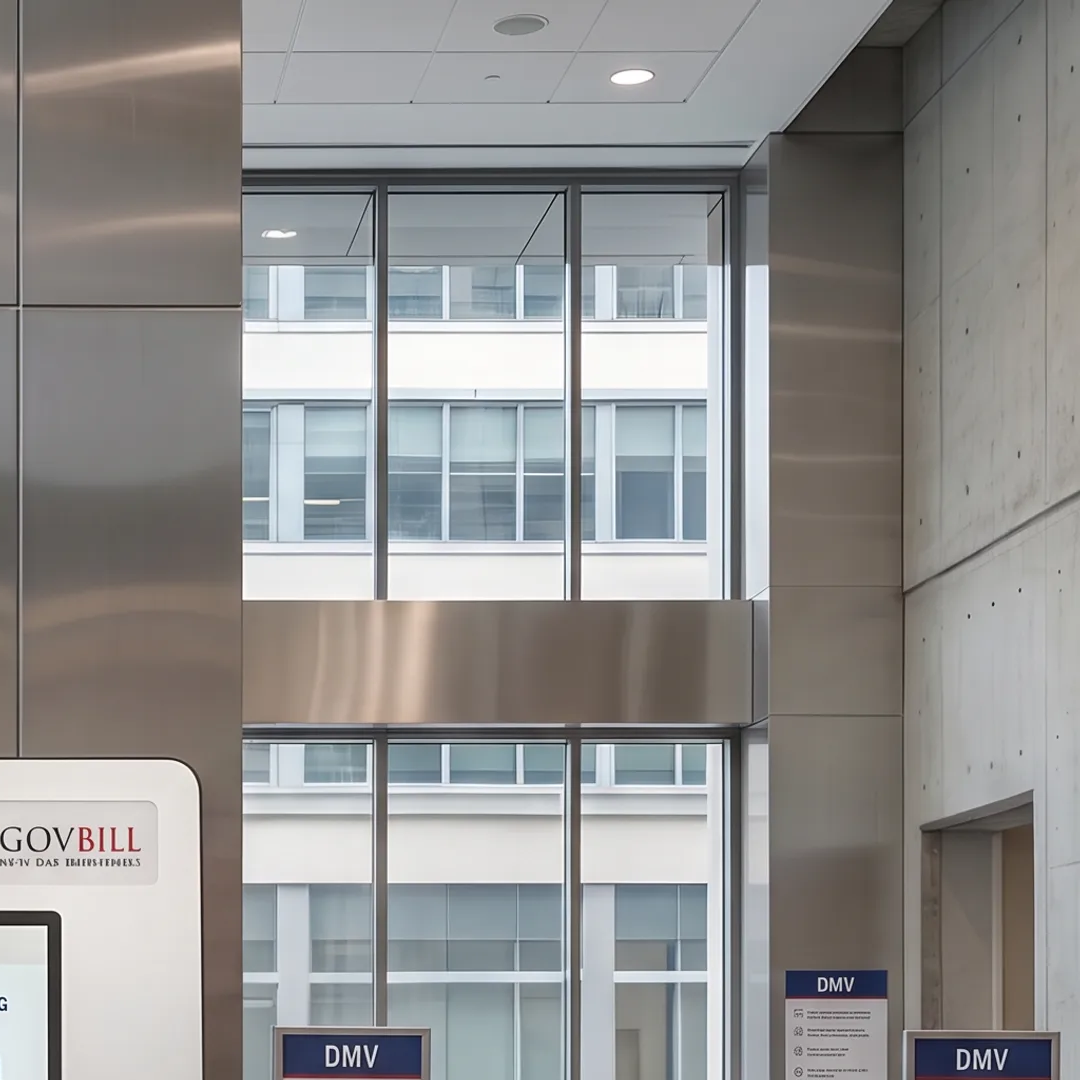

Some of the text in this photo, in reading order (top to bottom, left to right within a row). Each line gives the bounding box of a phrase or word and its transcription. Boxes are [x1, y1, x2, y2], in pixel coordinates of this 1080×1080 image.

[817, 976, 855, 993] DMV
[325, 1044, 379, 1069] DMV
[956, 1048, 1009, 1071] DMV
